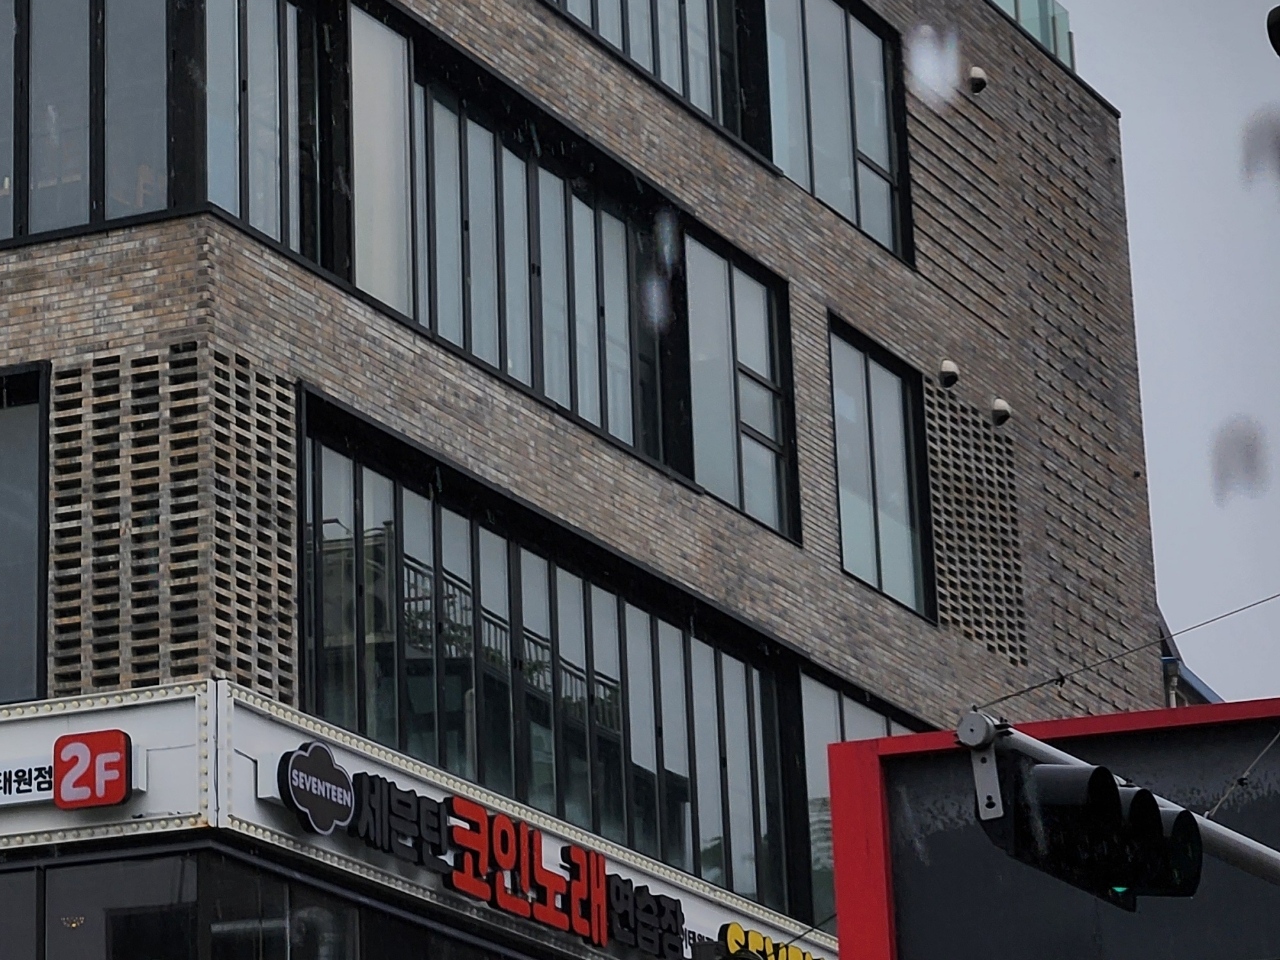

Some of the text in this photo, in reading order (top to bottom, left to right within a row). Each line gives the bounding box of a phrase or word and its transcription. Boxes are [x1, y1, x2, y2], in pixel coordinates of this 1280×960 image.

[59, 740, 122, 803] 2F
[291, 769, 353, 808] SEVENTEEN
[451, 795, 610, 947] 코인노래
